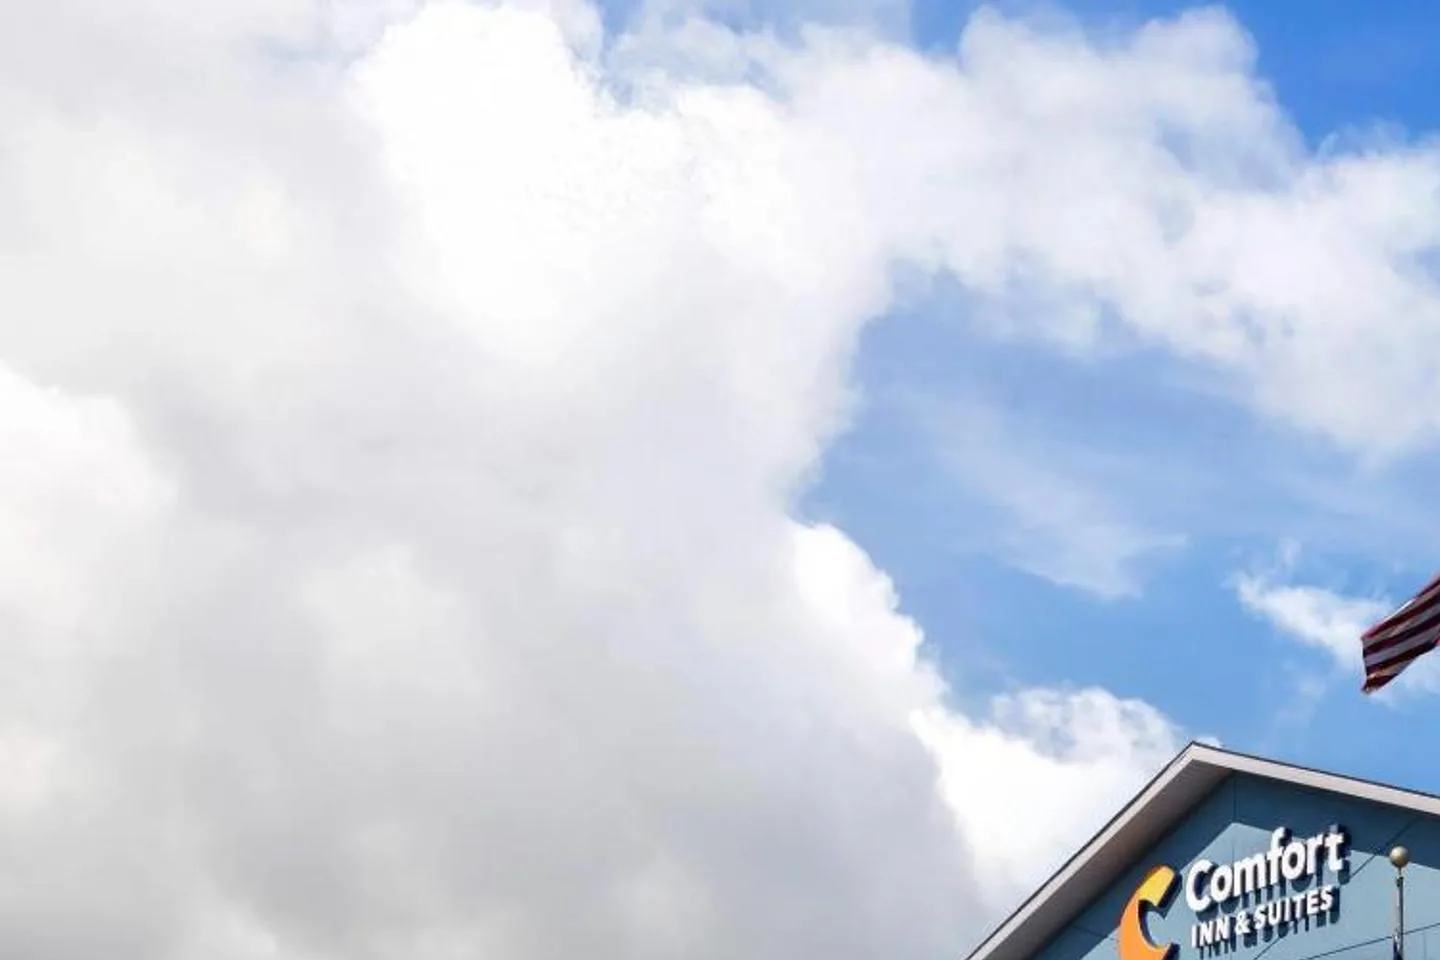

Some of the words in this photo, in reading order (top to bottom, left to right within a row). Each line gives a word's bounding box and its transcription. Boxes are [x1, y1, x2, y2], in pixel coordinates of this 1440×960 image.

[1186, 825, 1344, 912] Comfort
[1191, 915, 1231, 949] INN
[1235, 910, 1251, 936] &
[1254, 884, 1334, 931] SUITES
